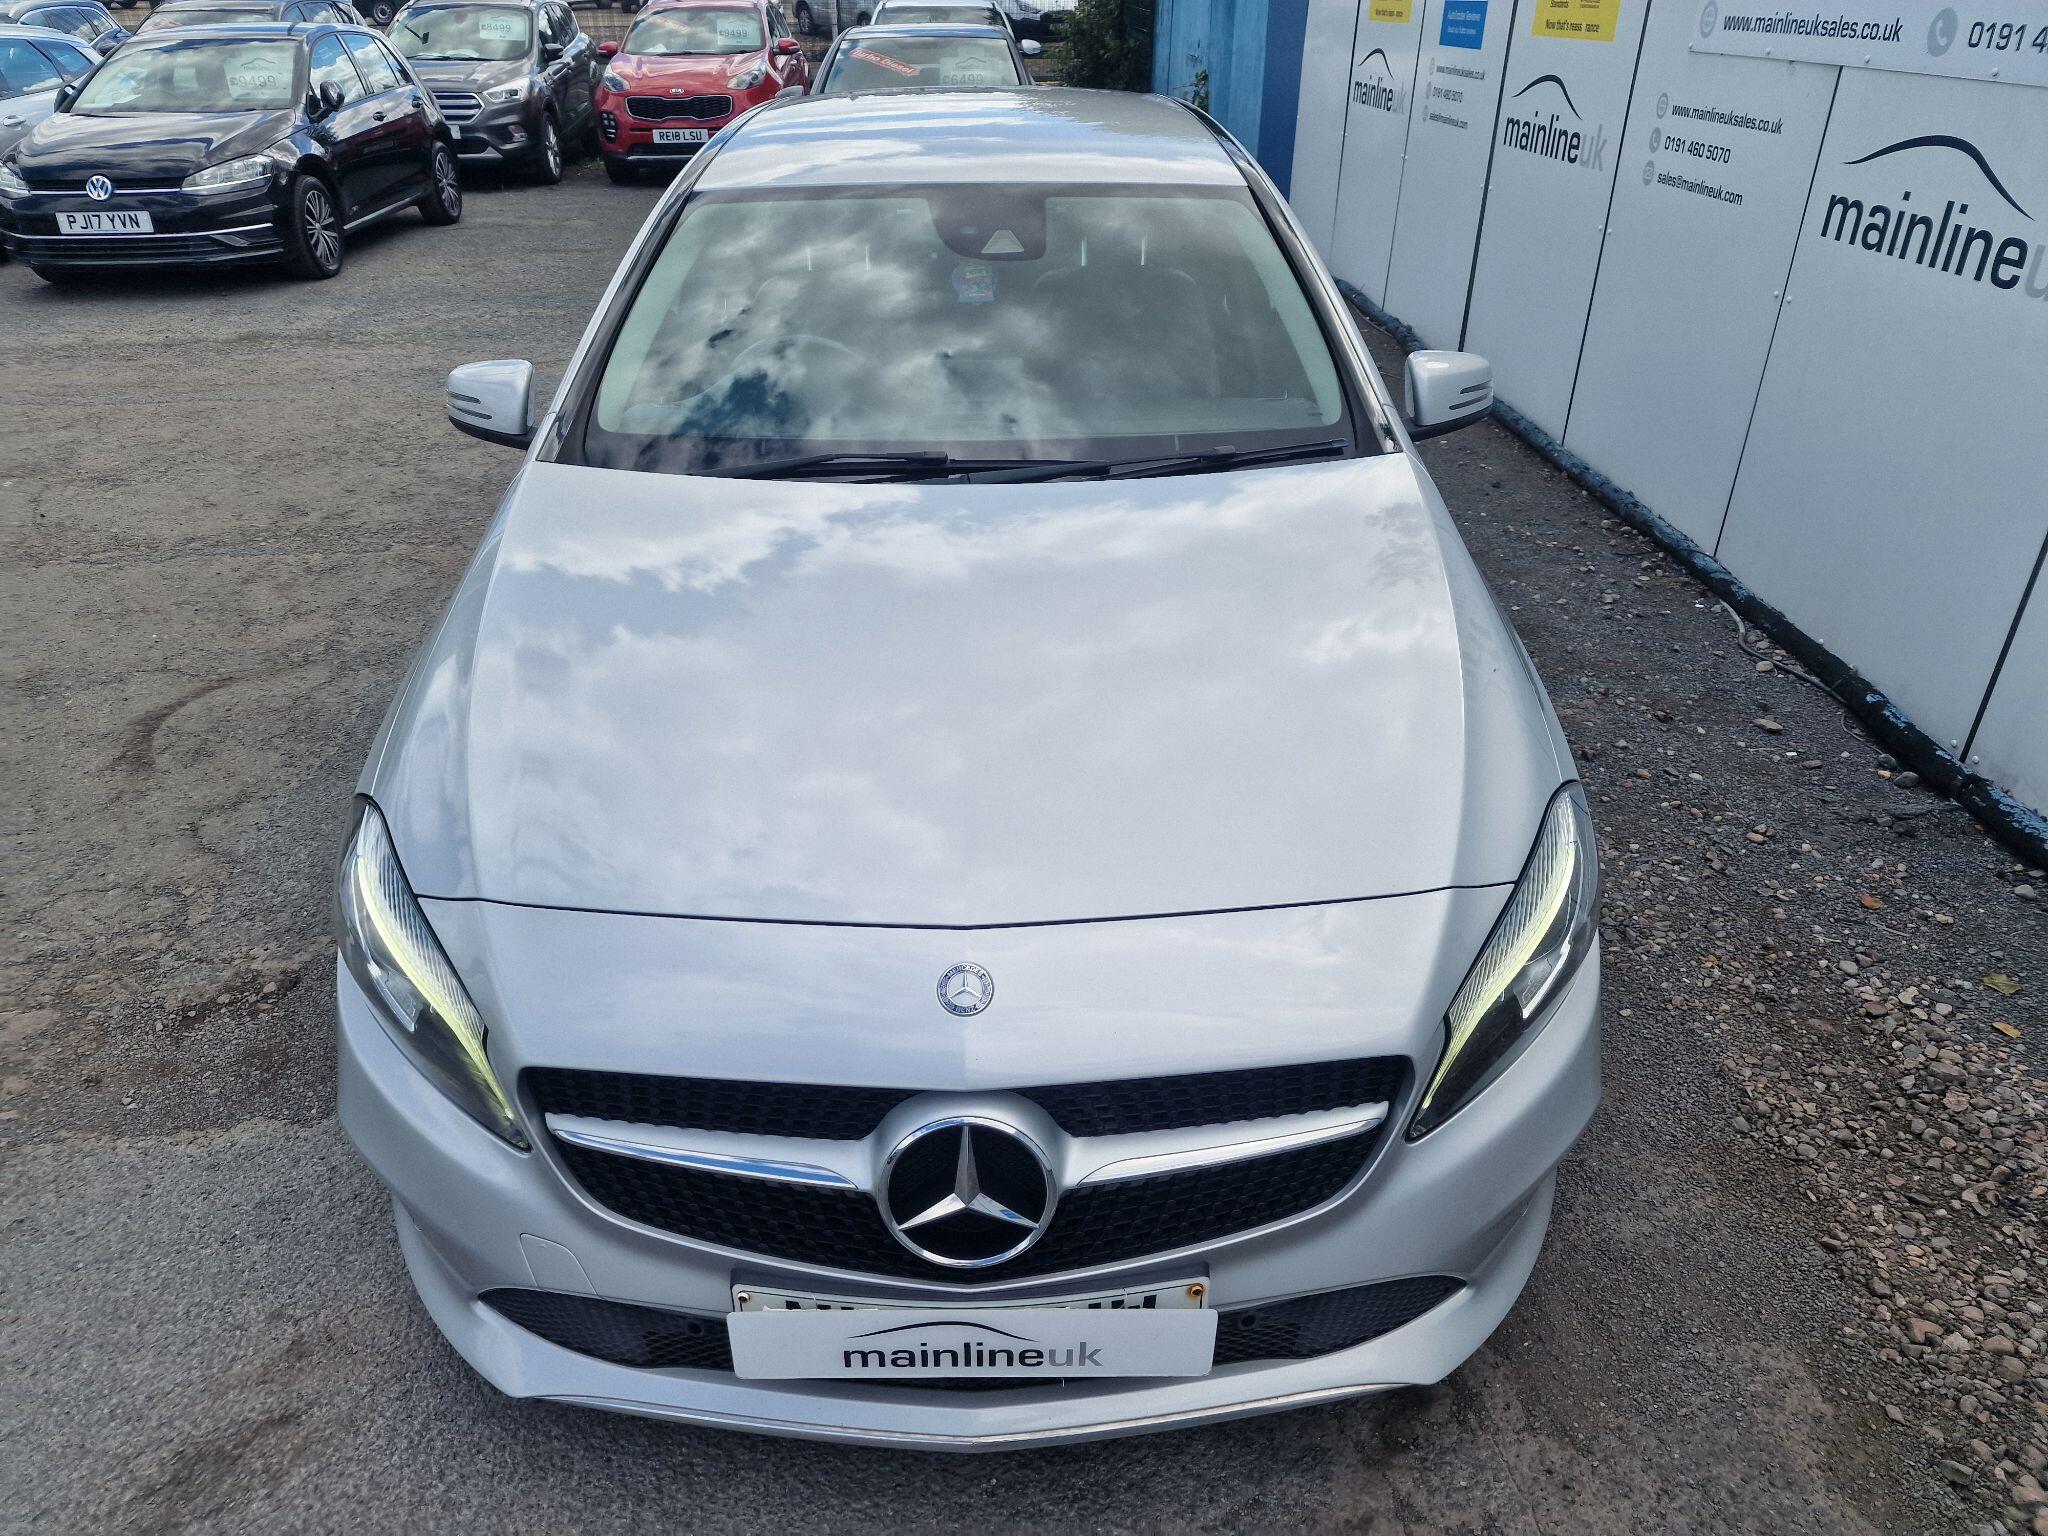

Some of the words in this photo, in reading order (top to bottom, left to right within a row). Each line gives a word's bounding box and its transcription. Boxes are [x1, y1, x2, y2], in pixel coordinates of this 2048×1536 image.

[1722, 12, 1903, 42] www.mainlineuksales.co.uk
[1968, 21, 2027, 52] 0191
[1353, 74, 1406, 115] mainlineuk
[1671, 104, 1784, 134] www.mainlineuksales.co.uk
[659, 131, 681, 141] RE18
[683, 131, 702, 141] LSU
[1503, 110, 1608, 171] mainlineuk
[1664, 135, 1686, 154] 0191
[1687, 140, 1706, 159] 460
[1706, 144, 1731, 164] 5070
[1657, 171, 1743, 205] sales@mainlineuk.com
[66, 214, 101, 230] PJ17
[106, 213, 141, 229] YVN
[842, 1341, 1104, 1369] mainlineuk
